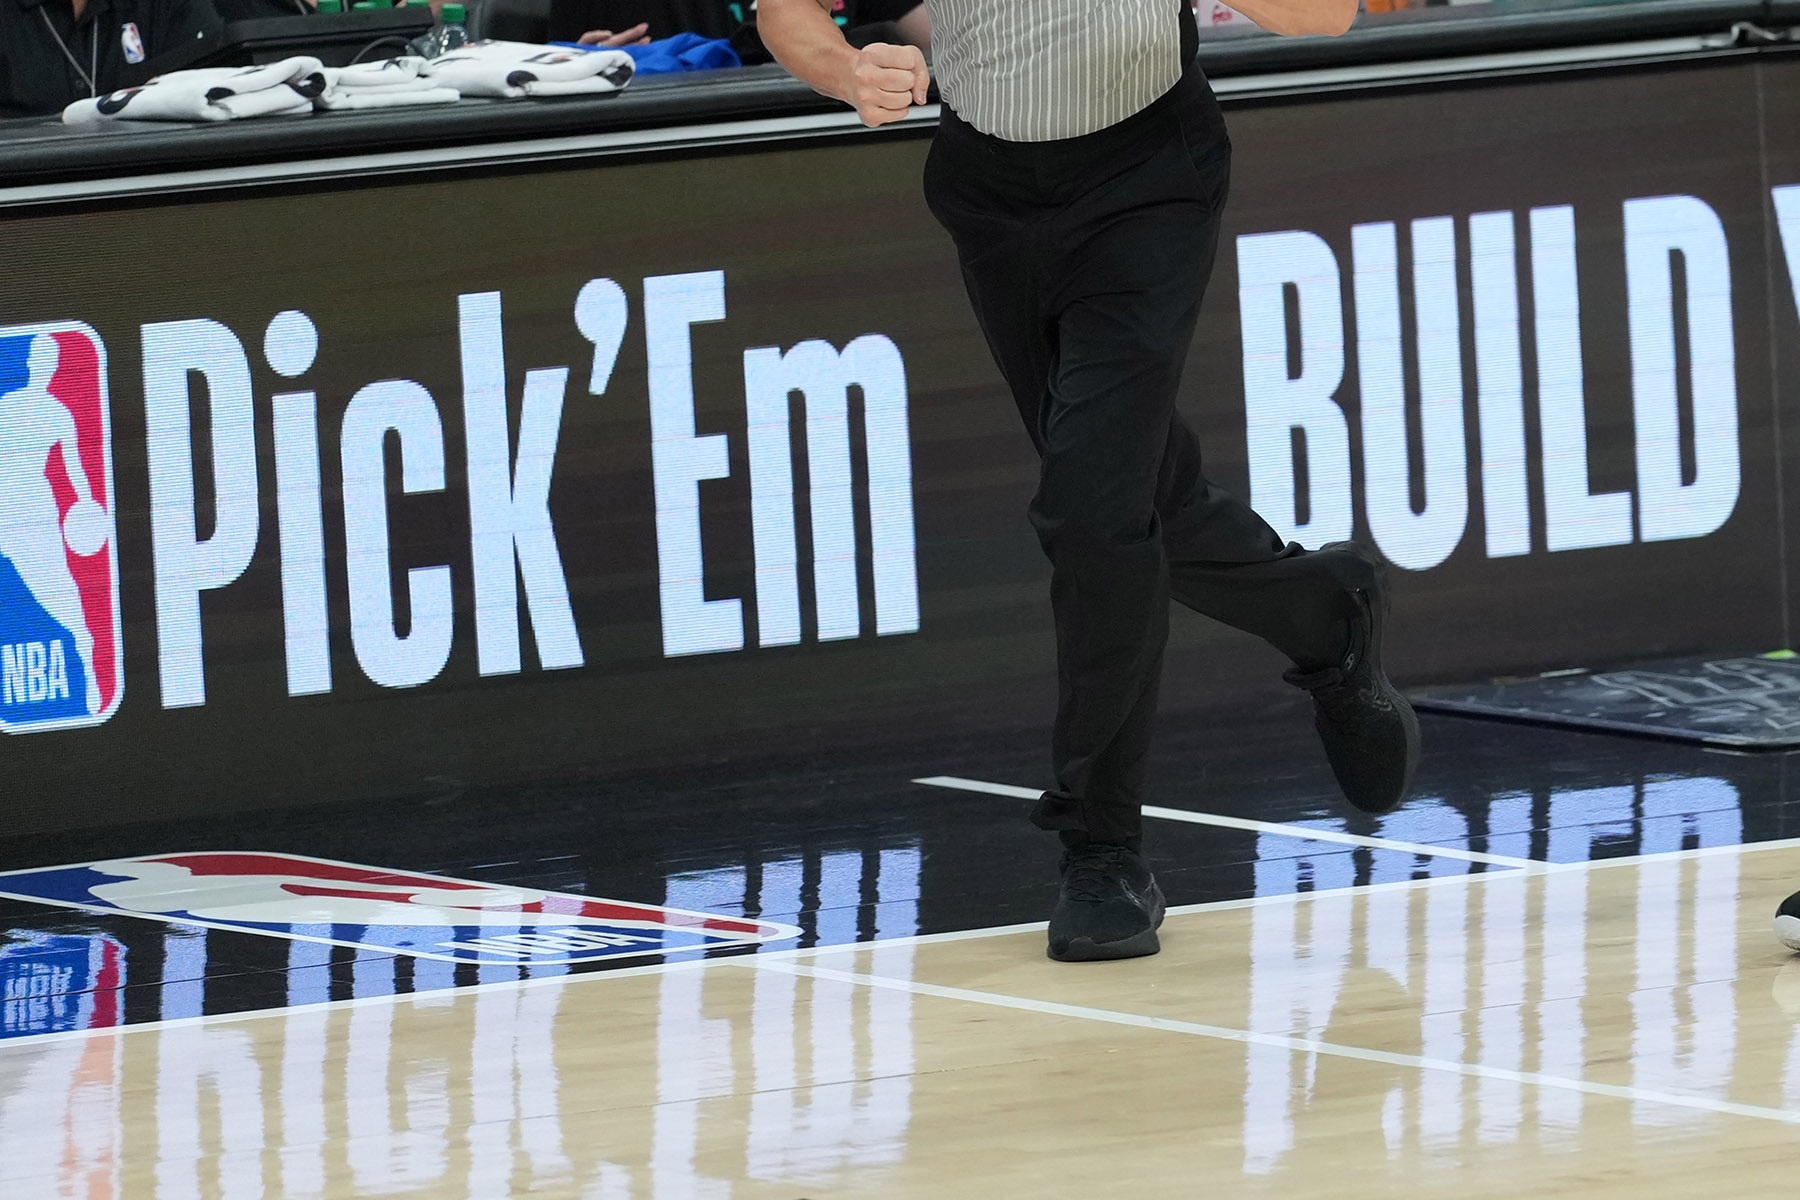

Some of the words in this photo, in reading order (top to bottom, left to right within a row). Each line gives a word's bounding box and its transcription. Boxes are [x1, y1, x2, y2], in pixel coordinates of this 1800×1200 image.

[2, 639, 70, 704] NBA
[140, 269, 920, 710] Pick'Em
[1236, 193, 1741, 572] BUILD
